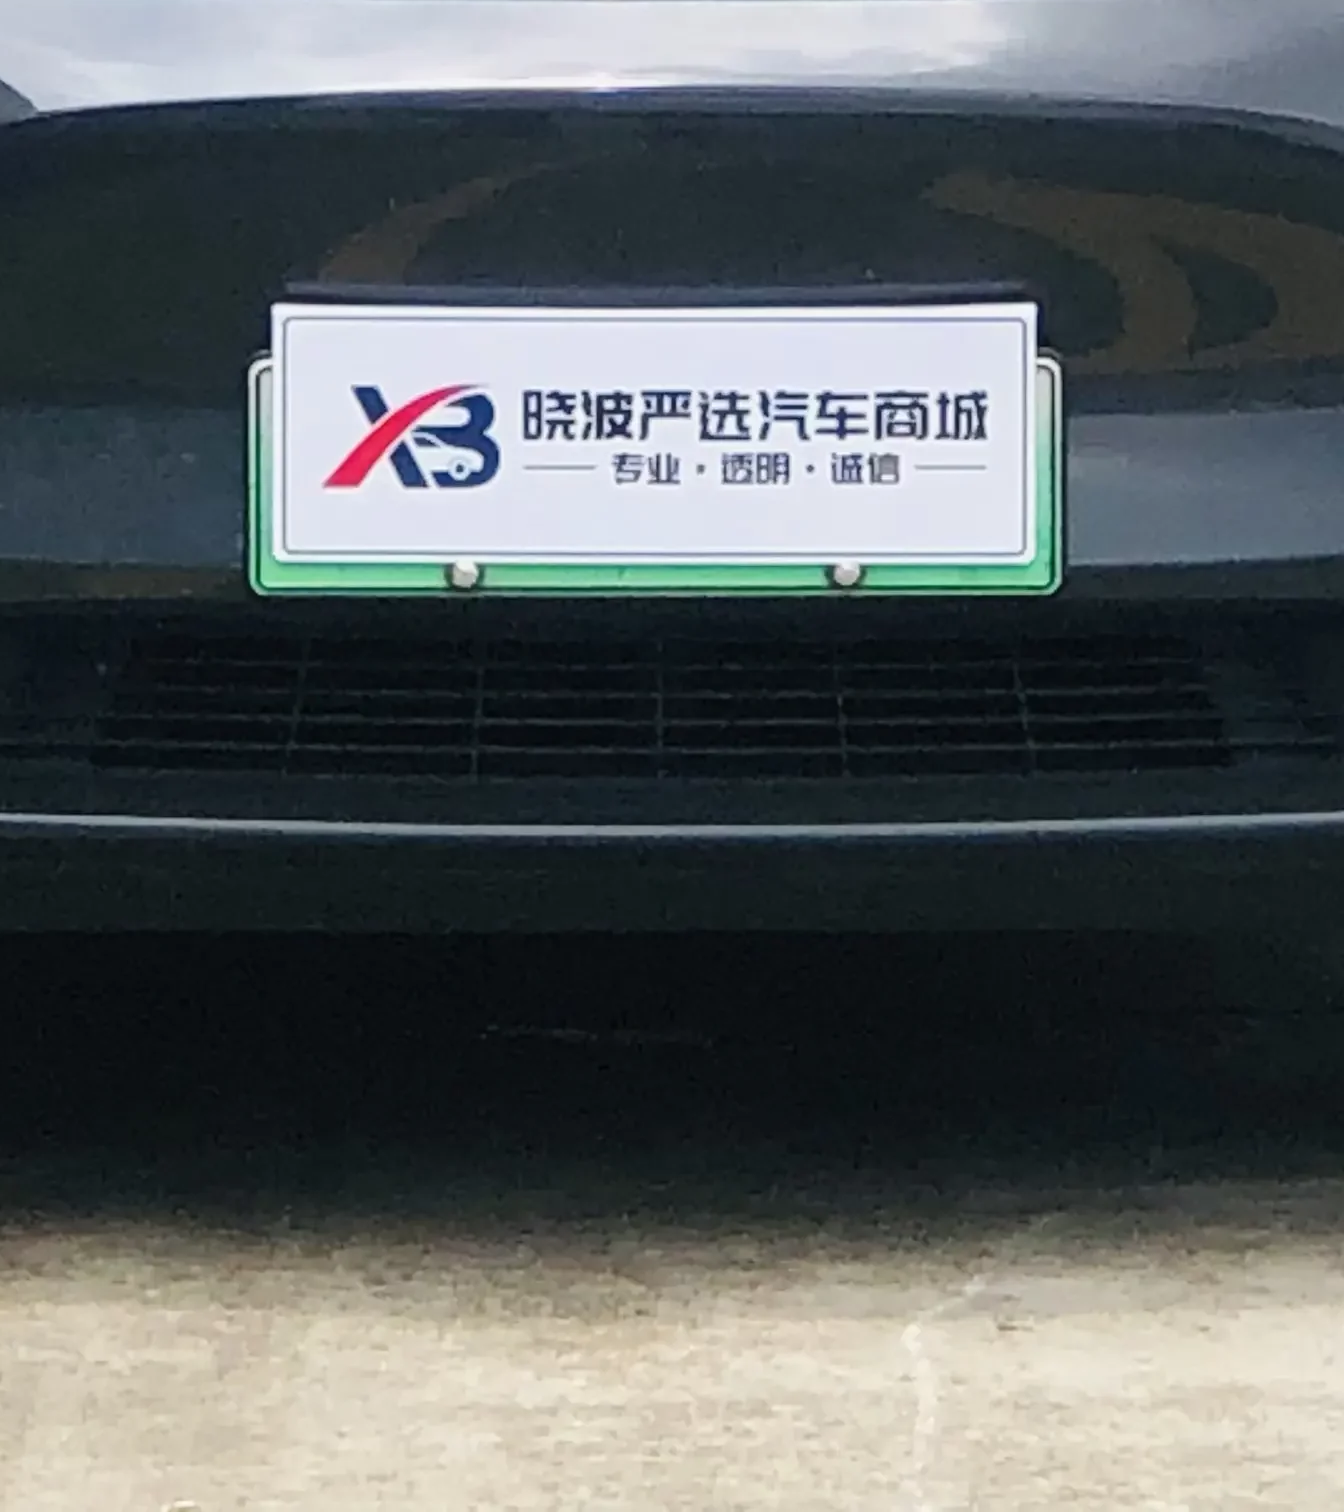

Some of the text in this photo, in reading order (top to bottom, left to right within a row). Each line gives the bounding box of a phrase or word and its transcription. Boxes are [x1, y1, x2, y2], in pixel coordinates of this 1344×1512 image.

[521, 389, 989, 442] 晓波严选汽车商城
